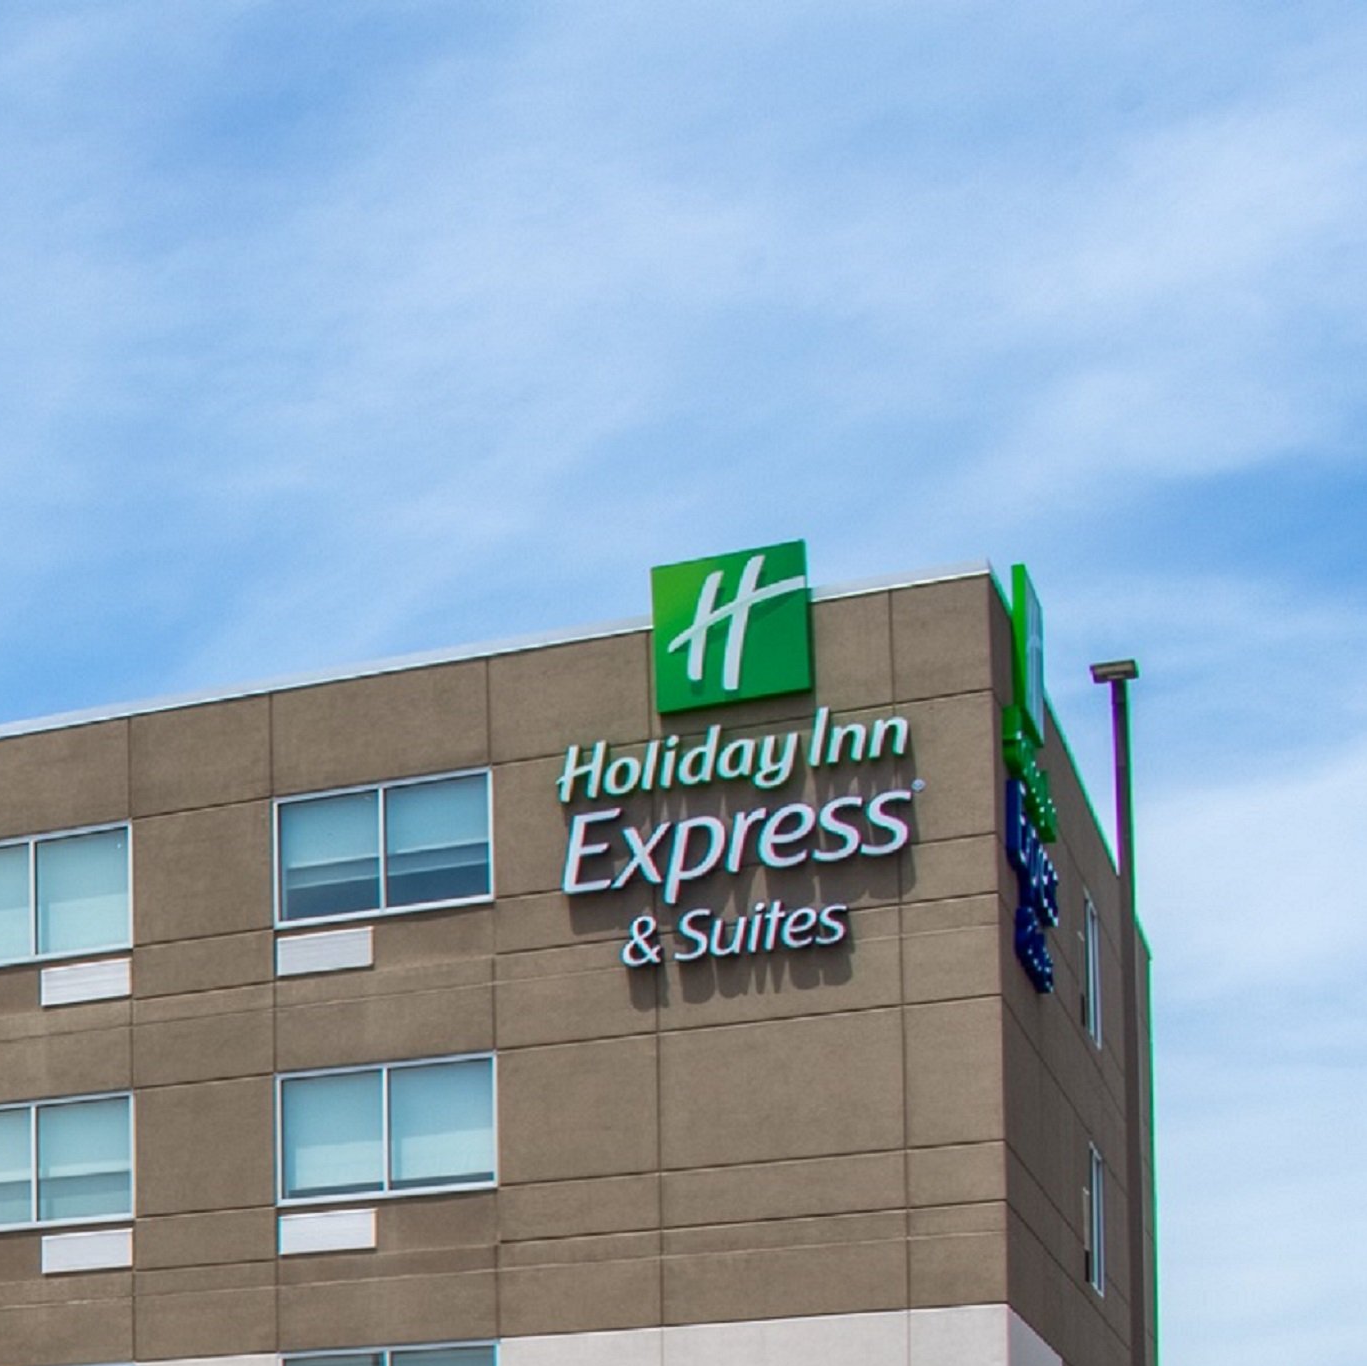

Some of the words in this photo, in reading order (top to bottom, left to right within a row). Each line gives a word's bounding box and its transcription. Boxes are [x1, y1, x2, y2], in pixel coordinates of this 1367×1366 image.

[555, 723, 799, 803] Holiday
[808, 705, 909, 768] Inn
[562, 789, 913, 904] Express
[621, 914, 662, 968] &
[673, 900, 848, 961] Suites
